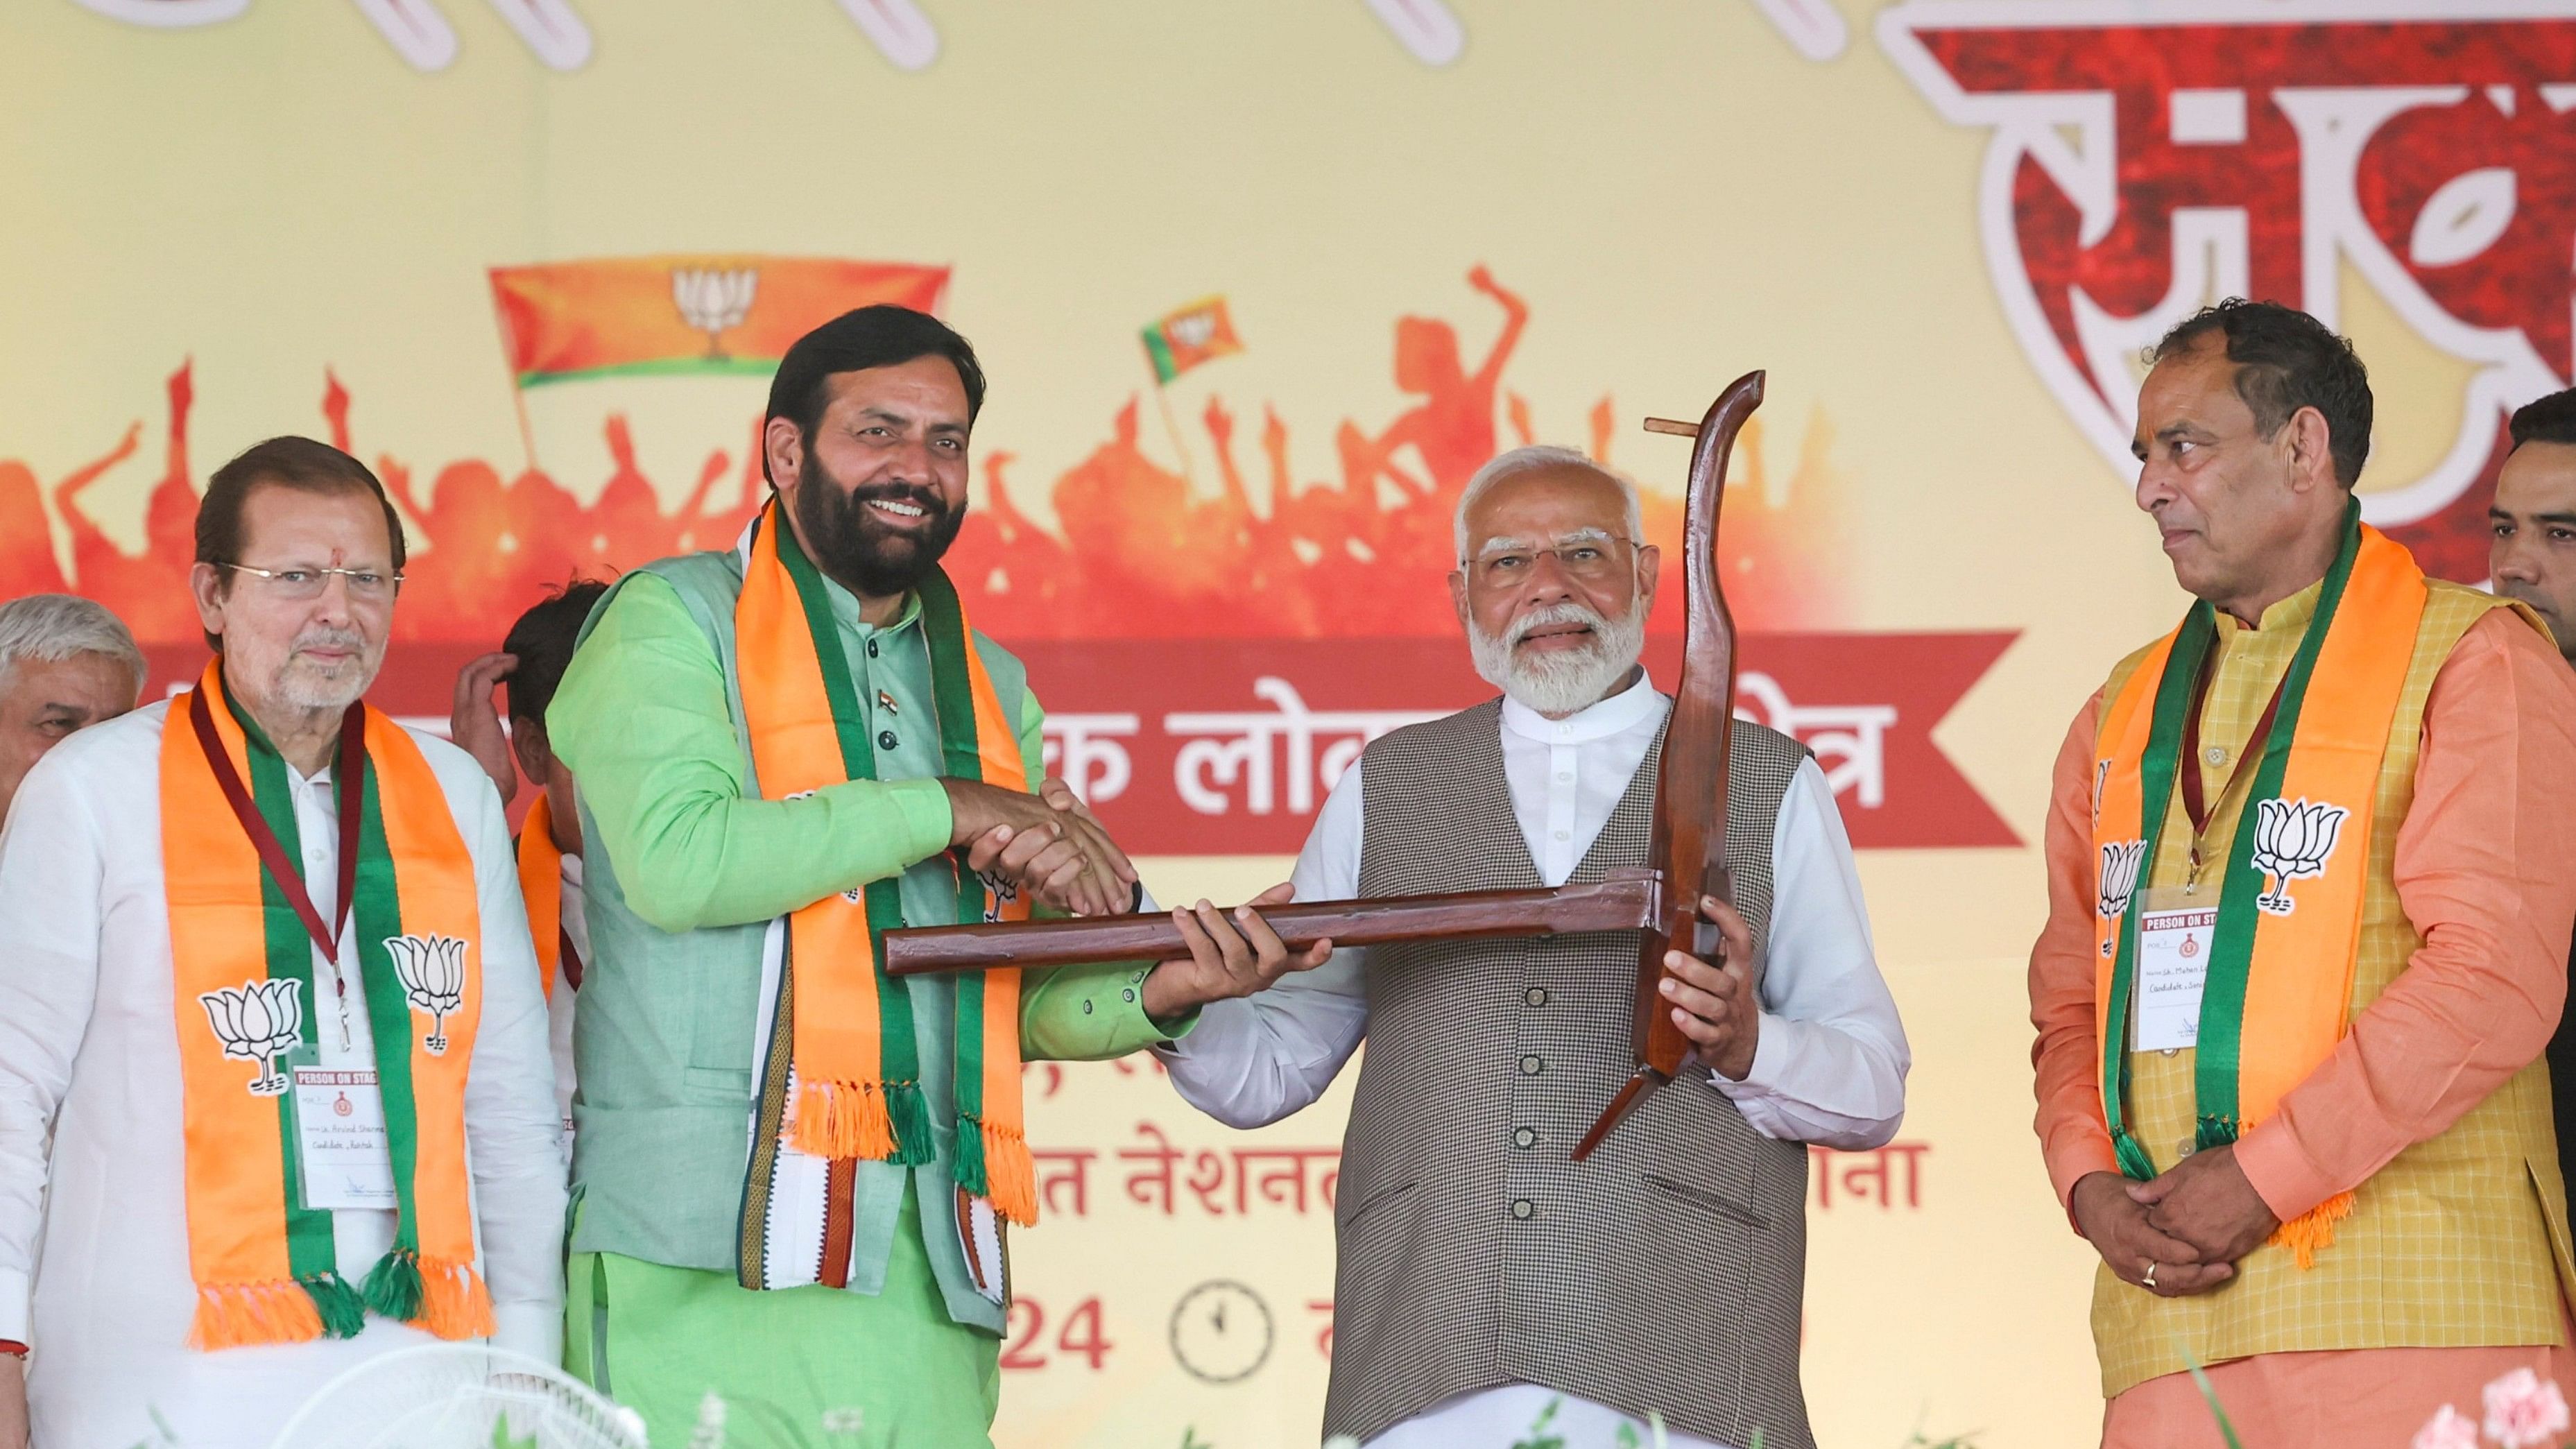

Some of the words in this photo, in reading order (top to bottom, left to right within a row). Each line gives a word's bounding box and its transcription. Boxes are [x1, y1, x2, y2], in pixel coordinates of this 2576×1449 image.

[2147, 916, 2184, 929] PERSON
[2188, 914, 2201, 925] ON
[2204, 913, 2217, 925] ST
[298, 1072, 335, 1083] PERSON
[337, 1072, 352, 1083] ON
[353, 1072, 377, 1083] STAG
[999, 1297, 1113, 1369] 24
